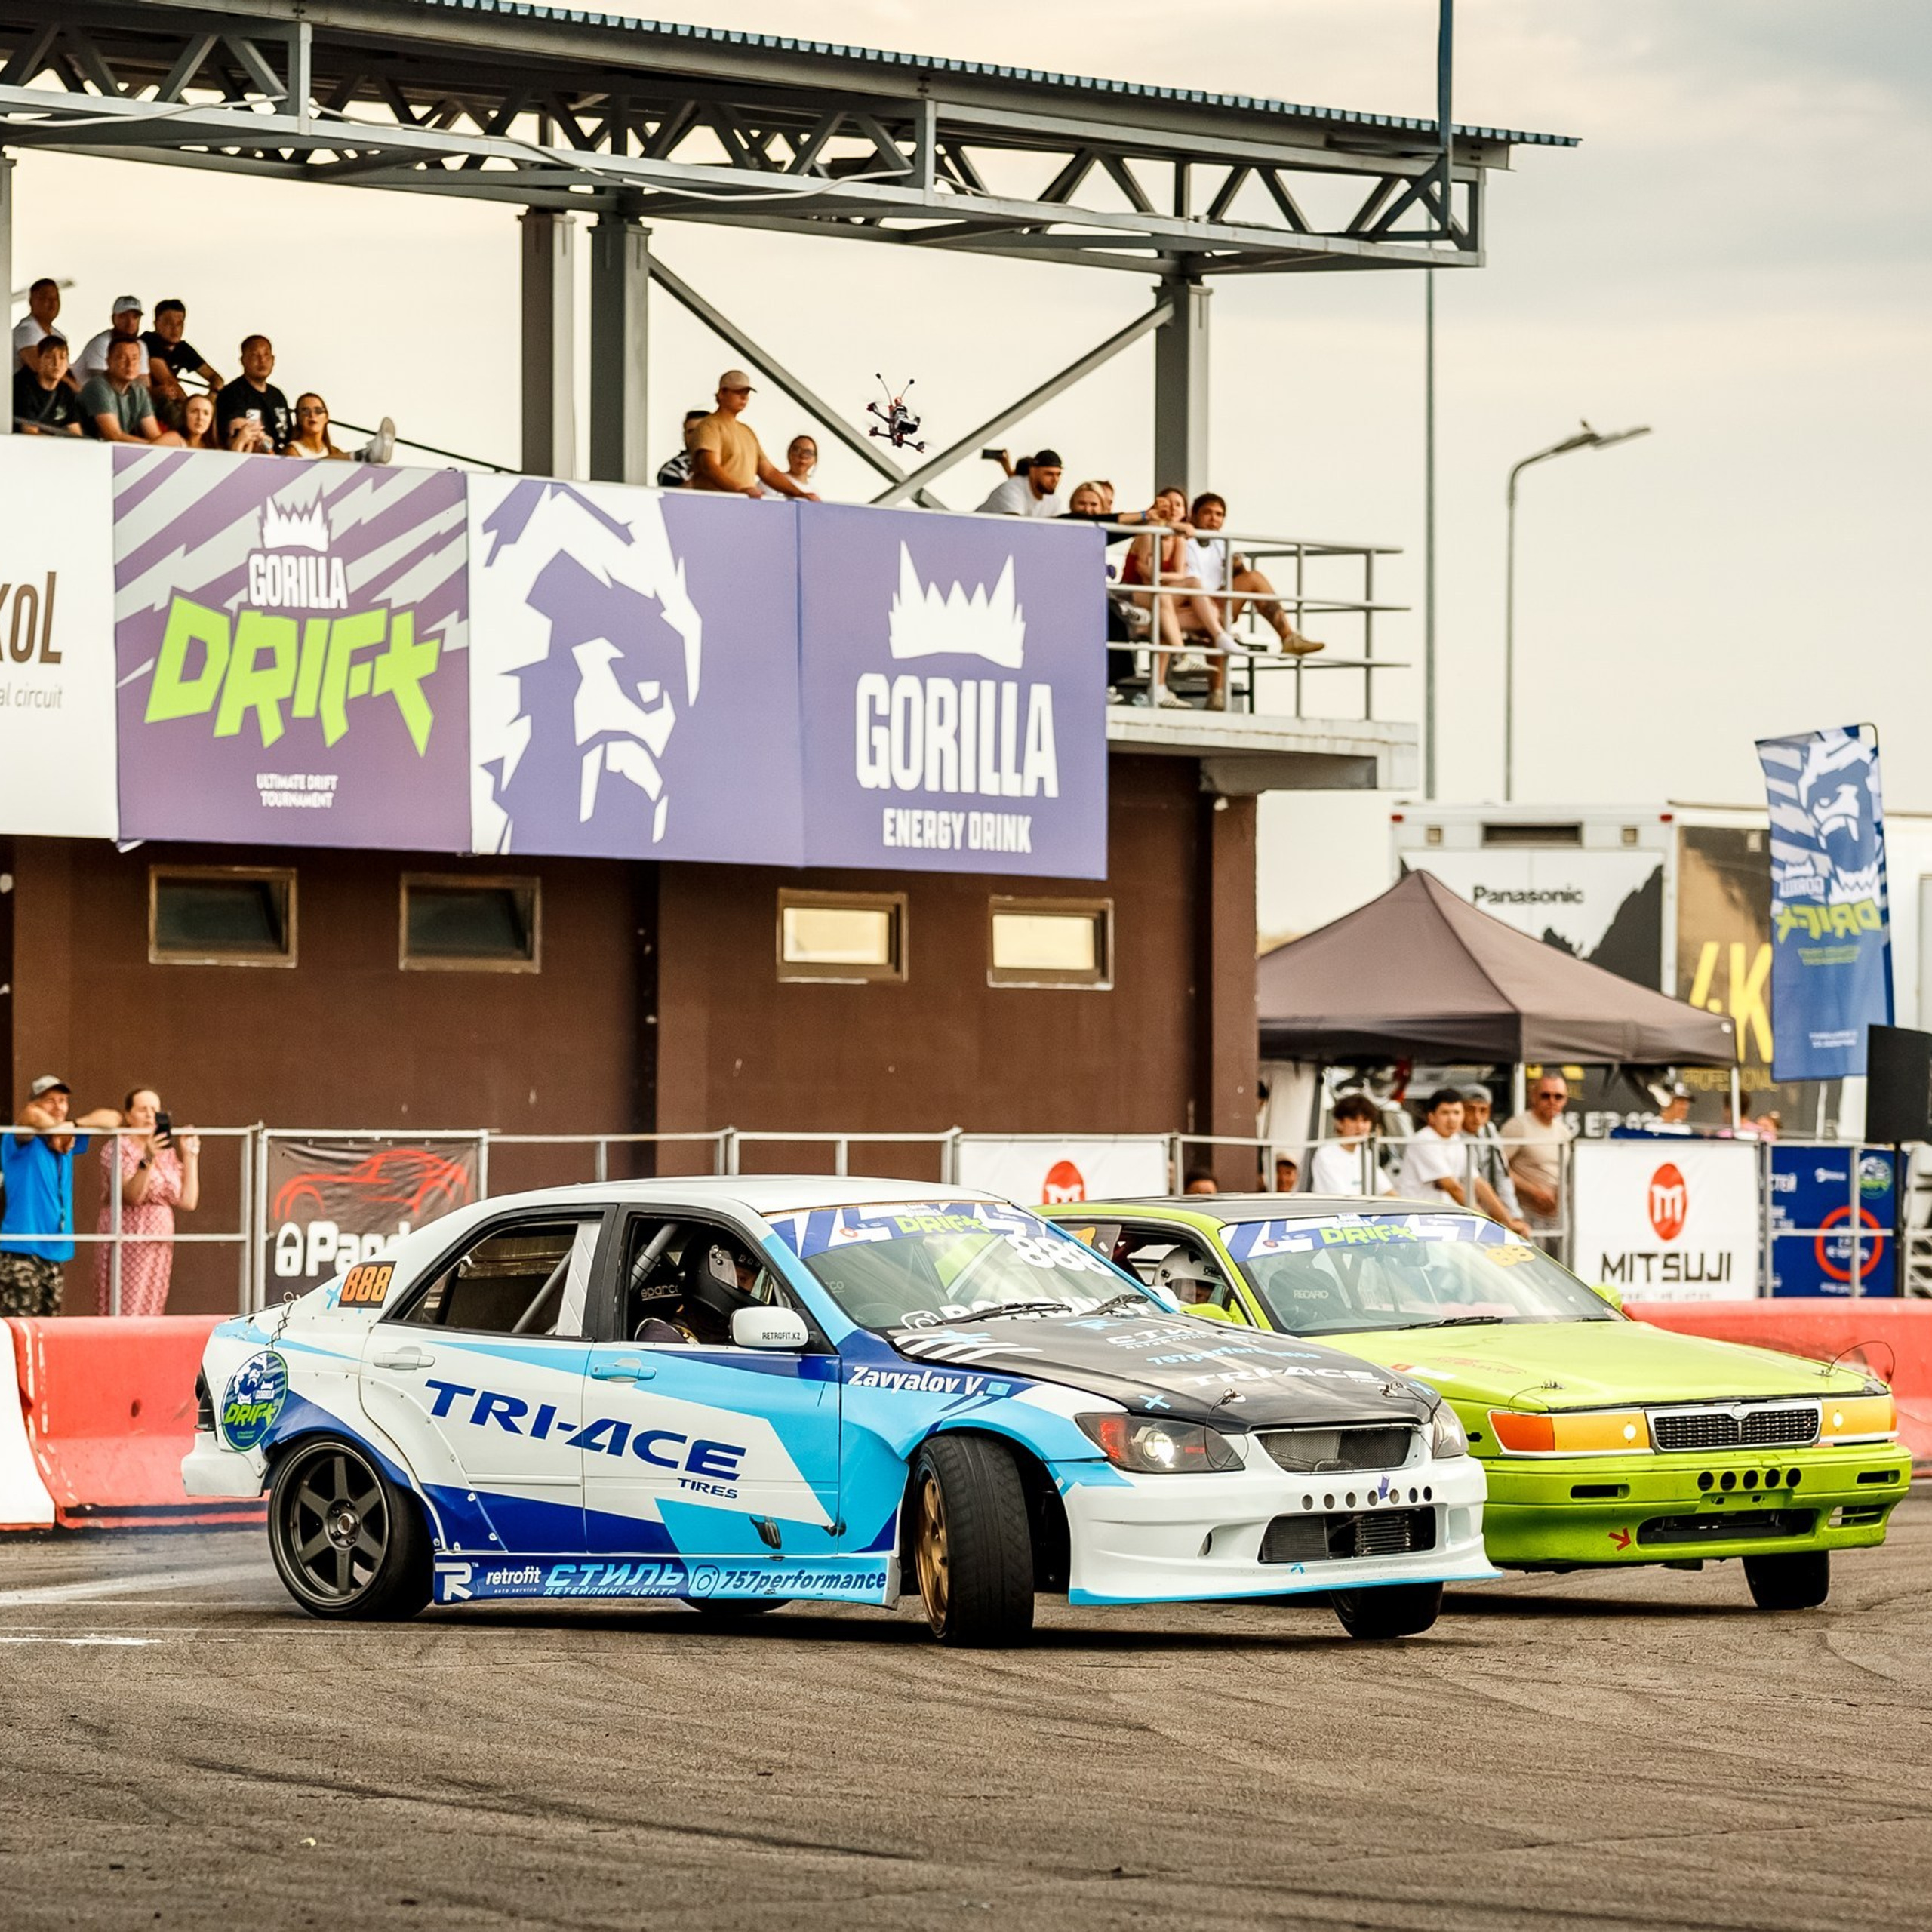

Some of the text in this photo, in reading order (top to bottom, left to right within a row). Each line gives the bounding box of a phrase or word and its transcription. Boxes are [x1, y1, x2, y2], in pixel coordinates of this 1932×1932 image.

[248, 553, 349, 609] GORILLA
[144, 595, 441, 758] DRIFT
[14, 683, 63, 709] circuit
[856, 672, 1059, 798] GORILLA
[256, 773, 339, 791] ULTIMATE DRIFT
[260, 790, 334, 808] TOURNAMENT
[883, 808, 1032, 854] ENERGY DRINK
[1473, 886, 1583, 905] Panasonic
[894, 1215, 991, 1234] DRIFT
[1319, 1223, 1417, 1245] DRIFT
[1601, 1251, 1731, 1283] MITSUJI
[340, 1266, 394, 1303] 888
[1294, 1289, 1329, 1300] RECARO
[761, 1331, 801, 1340] RETROFIT.KZ
[848, 1366, 985, 1396] Zavyalov V.
[1182, 1367, 1380, 1387] TRI-ACE
[223, 1402, 277, 1427] DRIFT
[425, 1378, 746, 1481] TRI-ACE
[677, 1477, 738, 1499] TIRES
[485, 1566, 542, 1585] retrofit
[544, 1564, 684, 1587] СТИЛЬ
[721, 1569, 887, 1594] 757performance
[543, 1586, 678, 1596] ДЕТЕЙЛИНГ-ЦЕНТР
